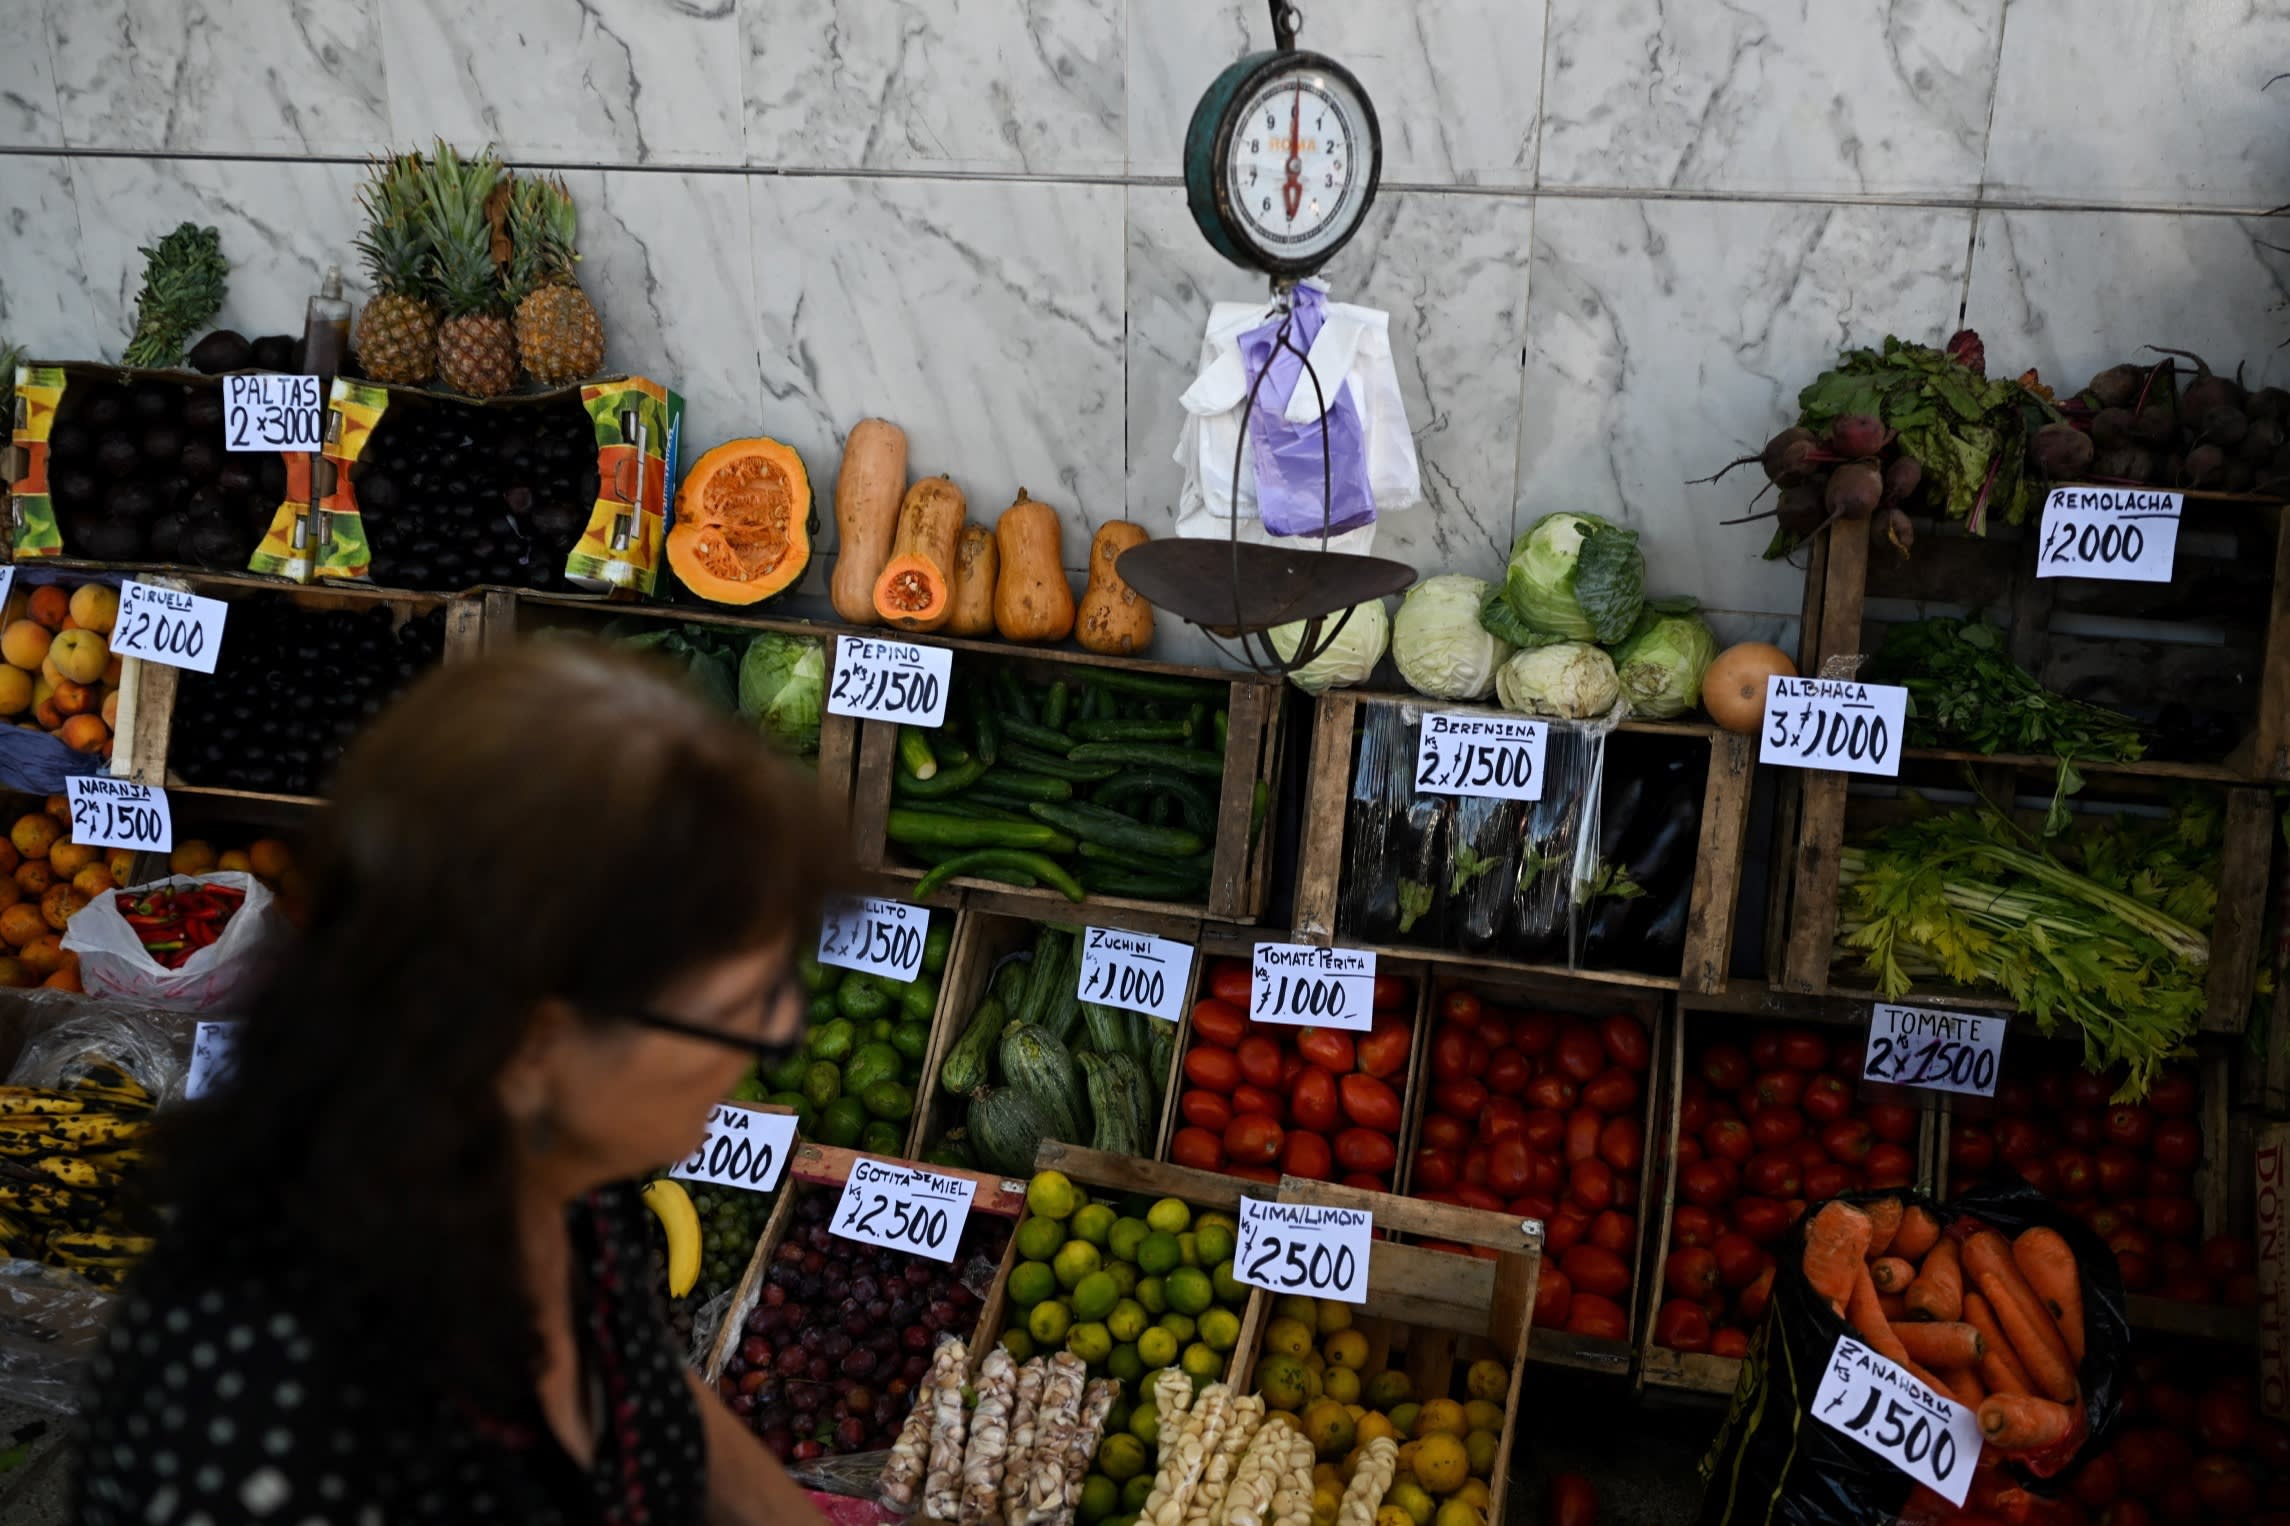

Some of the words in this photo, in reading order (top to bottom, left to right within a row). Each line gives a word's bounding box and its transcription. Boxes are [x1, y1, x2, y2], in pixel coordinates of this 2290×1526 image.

[1266, 114, 1276, 130] 9
[1315, 117, 1323, 131] 1
[1250, 139, 1260, 154] 8
[1326, 140, 1335, 154] 2
[1325, 174, 1334, 188] 3
[1262, 196, 1272, 211] 6
[231, 376, 318, 407] PALTAS
[2052, 490, 2173, 511] REMOLACHA
[131, 585, 193, 609] CIRUELA
[845, 638, 920, 663] PEPINO
[1775, 677, 1868, 701] ALBHACA
[1432, 716, 1536, 737] BERENJENA
[78, 779, 152, 799] NARANJA
[1090, 930, 1151, 954] ZUCHINI
[1257, 945, 1315, 967] TOMATE
[1315, 947, 1364, 970] PERITA
[1884, 1009, 1982, 1042] TOMATE
[856, 1162, 910, 1187] GOTITA
[911, 1169, 932, 1183] DE
[931, 1177, 968, 1197] MIEL
[1249, 1202, 1365, 1227] LIMA/LIMON
[2256, 1146, 2279, 1262] DON
[1838, 1340, 1953, 1418] ZANAHORIA
